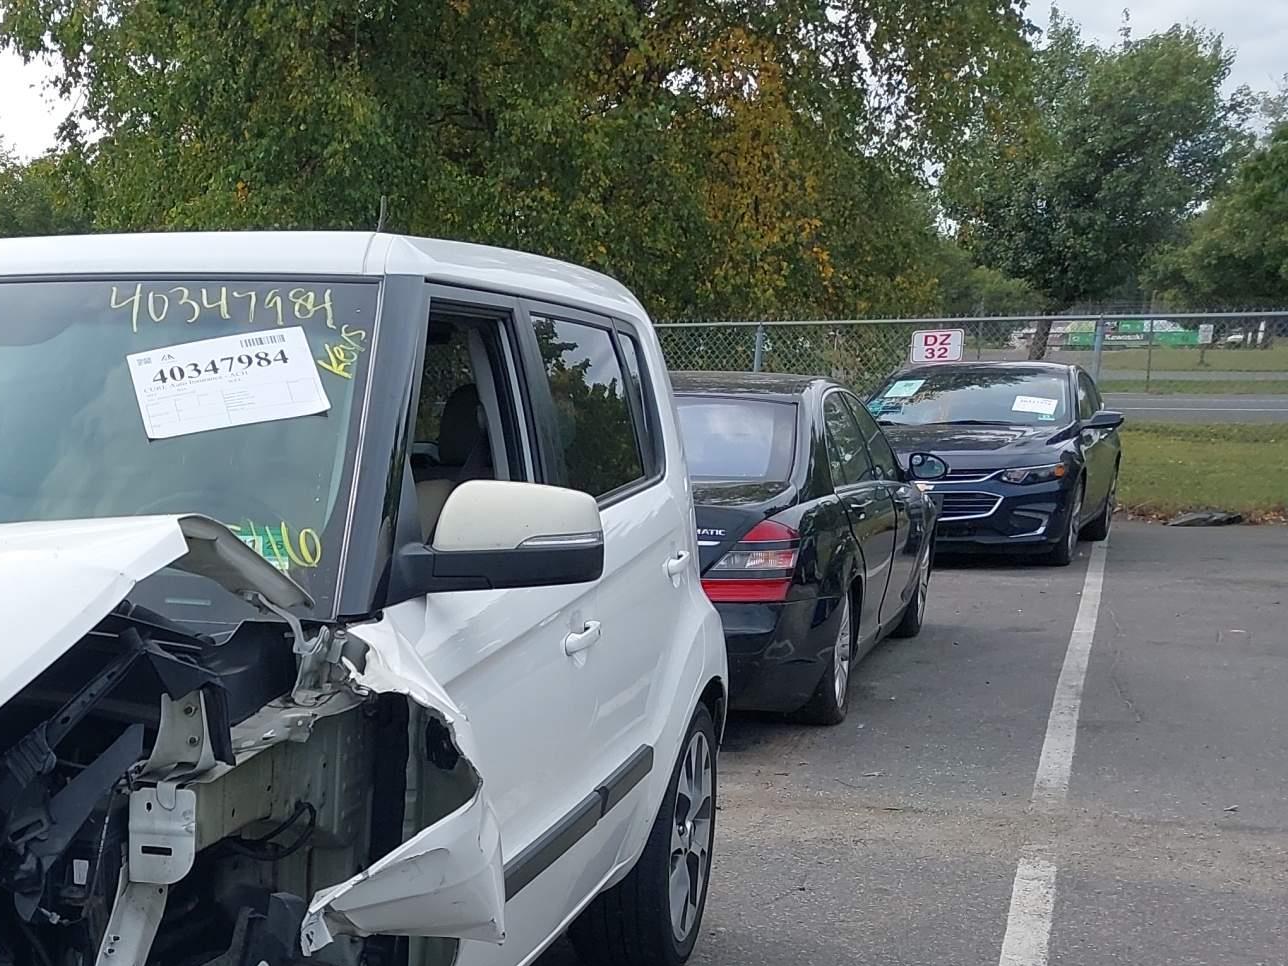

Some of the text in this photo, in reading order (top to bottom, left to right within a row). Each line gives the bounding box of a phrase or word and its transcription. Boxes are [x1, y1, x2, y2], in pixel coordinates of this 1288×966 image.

[110, 283, 336, 332] 40347984
[923, 333, 951, 346] DZ
[924, 347, 948, 359] 32
[152, 348, 289, 384] 40347984
